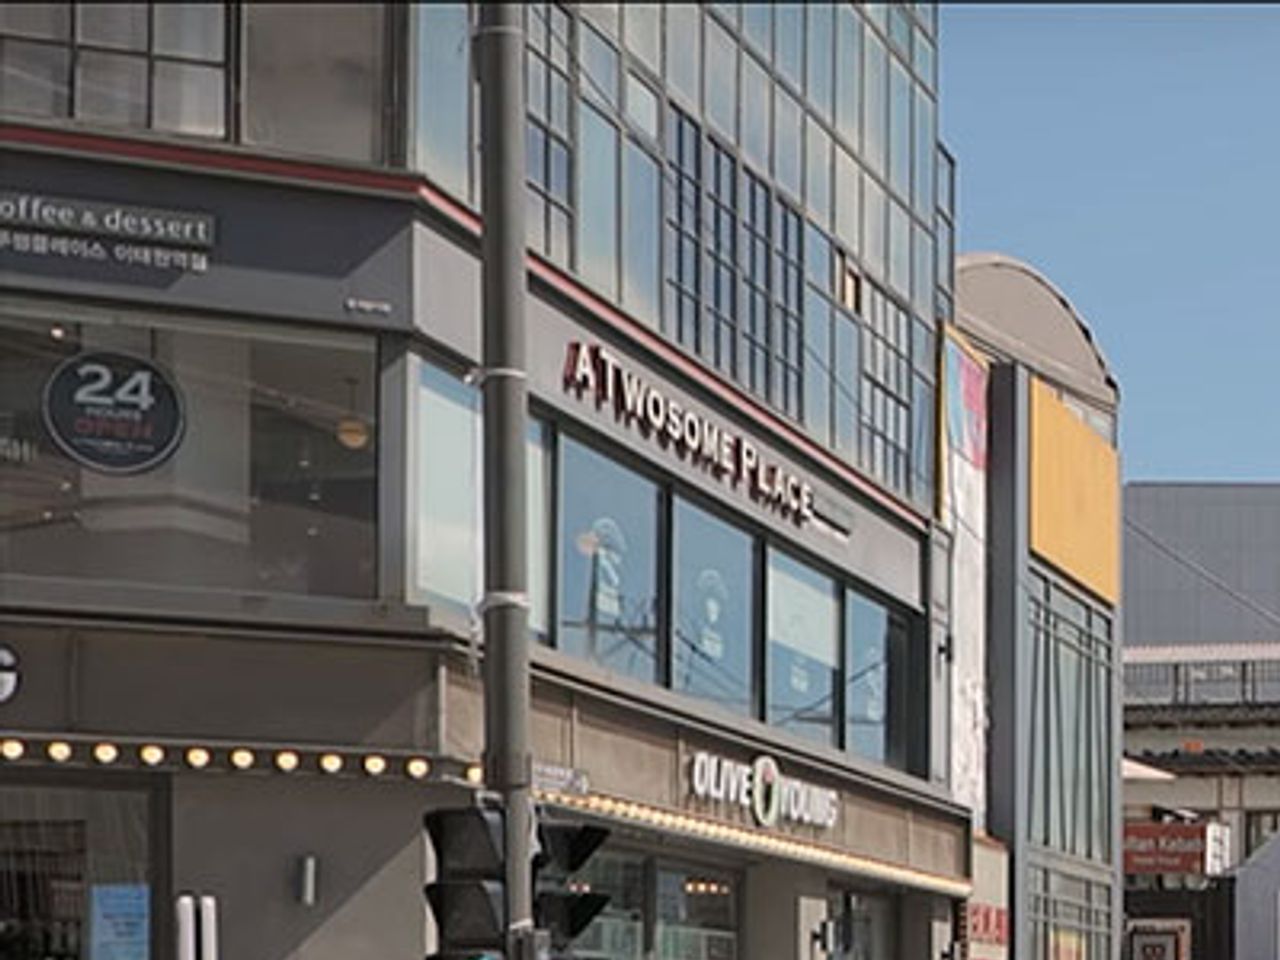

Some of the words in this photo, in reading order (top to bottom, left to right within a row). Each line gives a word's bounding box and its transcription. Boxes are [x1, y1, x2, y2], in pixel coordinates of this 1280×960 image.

[104, 209, 209, 241] dessert
[73, 363, 156, 411] 24
[599, 349, 736, 475] TWOSOME
[742, 445, 817, 518] PLACE
[693, 752, 752, 806] OLIVE
[777, 774, 839, 828] YOUNG
